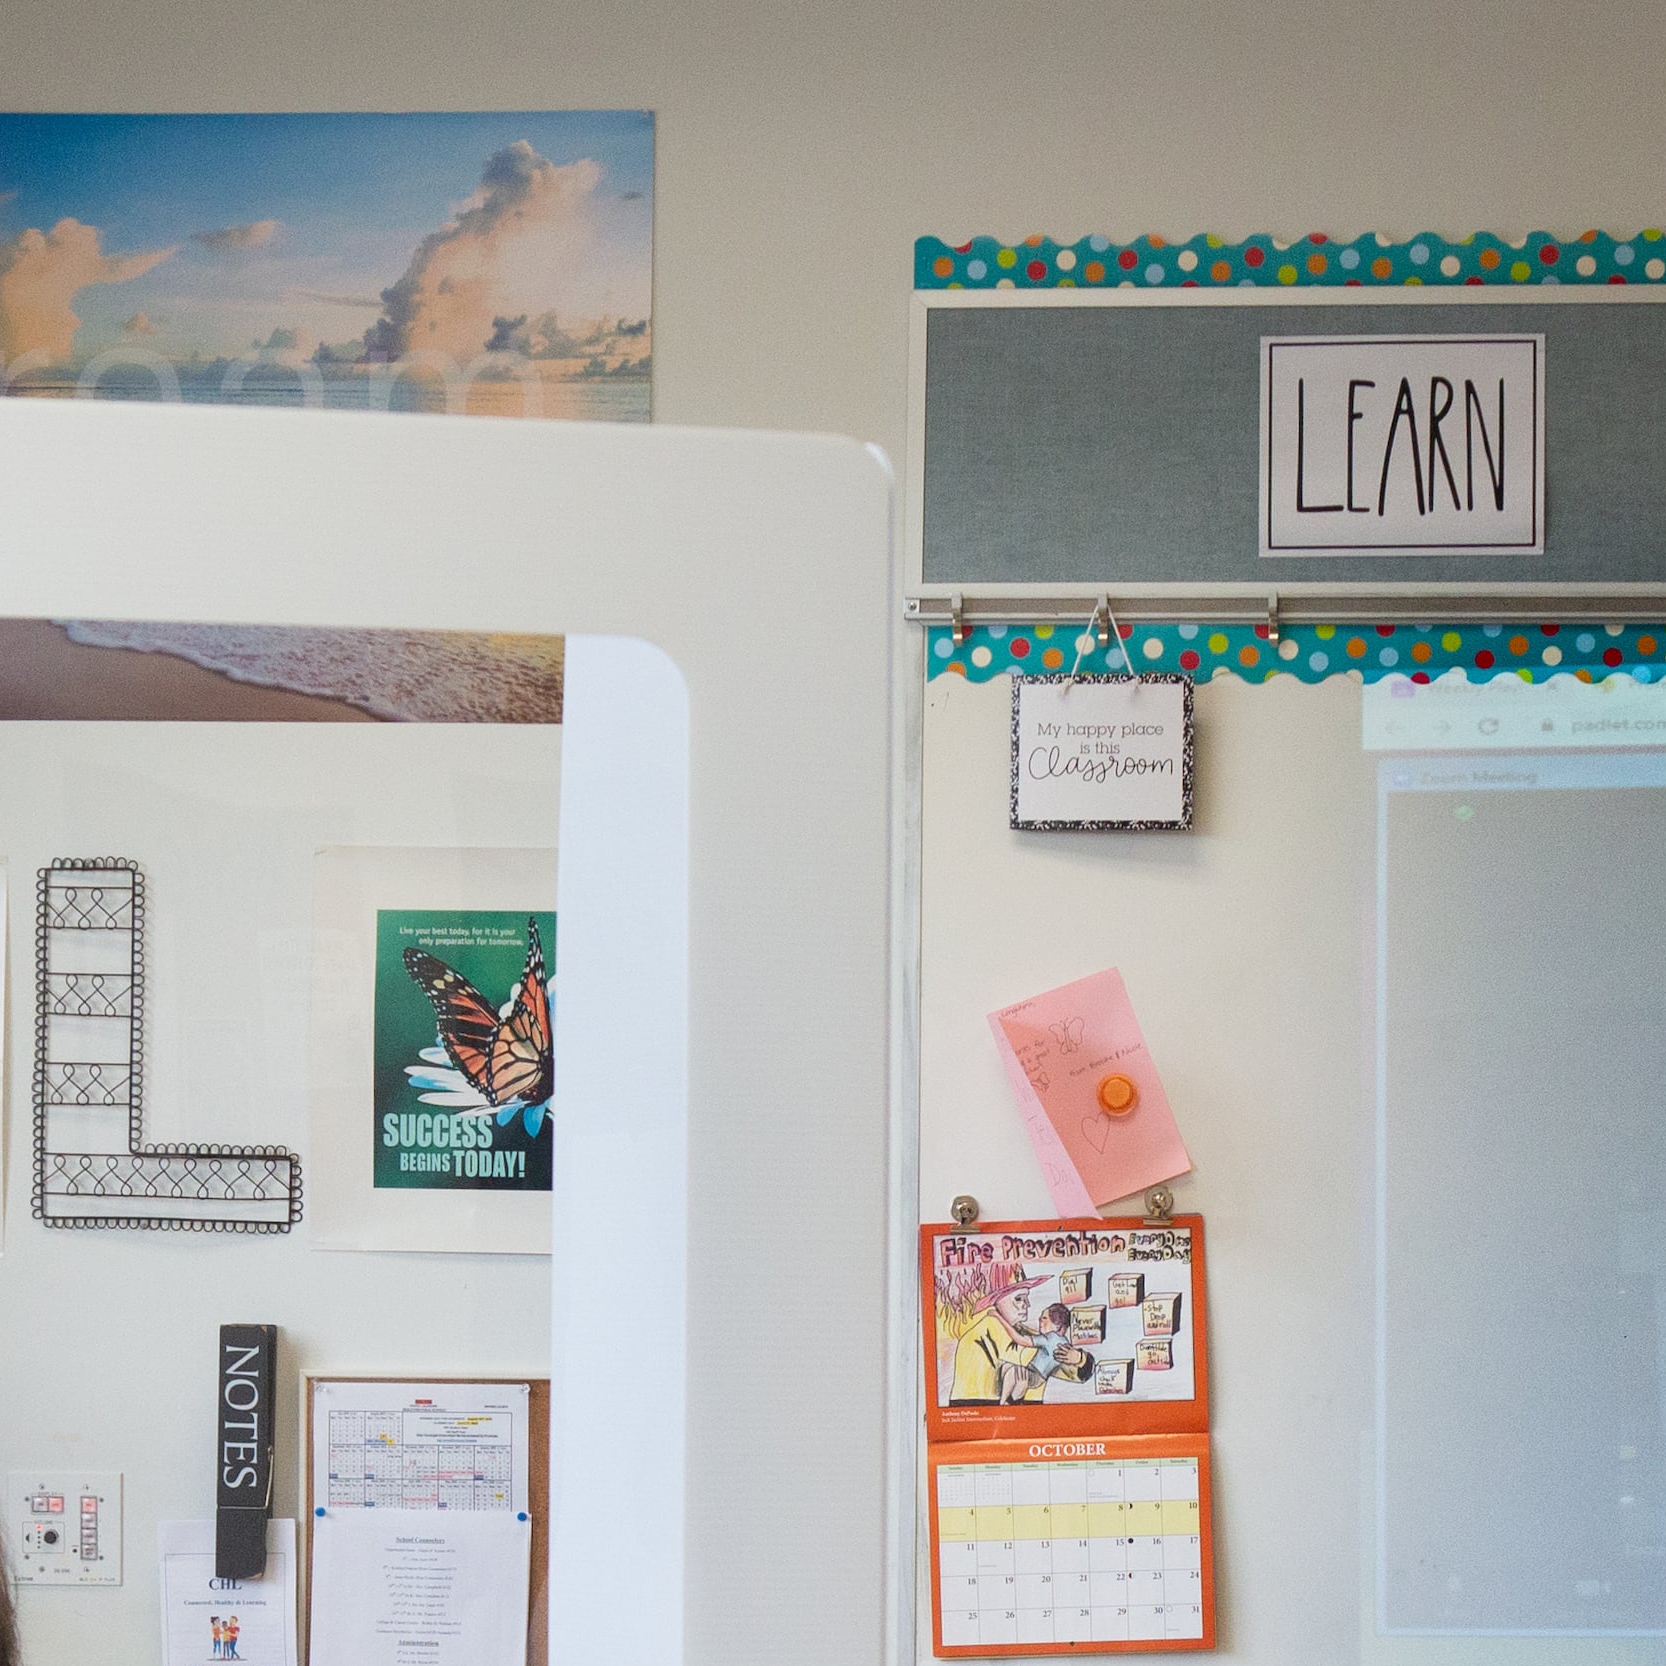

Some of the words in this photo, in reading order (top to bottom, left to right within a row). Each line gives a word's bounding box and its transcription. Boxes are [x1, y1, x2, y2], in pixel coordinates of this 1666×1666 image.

[1296, 375, 1505, 517] LEARN
[1037, 722, 1061, 738] My
[1066, 722, 1117, 739] happy
[1120, 722, 1164, 739] place
[1079, 741, 1091, 755] is
[1094, 741, 1121, 755] this
[1028, 746, 1174, 784] Classroom
[415, 928, 431, 936] your
[432, 927, 448, 935] best
[471, 927, 483, 935] for
[499, 928, 515, 937] your
[419, 937, 433, 946] only
[435, 938, 475, 946] preparation
[476, 938, 488, 946] for
[383, 1112, 493, 1149] SUCCESS
[400, 1152, 451, 1173] BEGINS
[452, 1149, 526, 1178] TODAY!
[940, 1237, 995, 1267] Fire
[1001, 1230, 1126, 1262] Prevention
[221, 1343, 260, 1490] NOTES
[1028, 1442, 1106, 1458] OCTOBER
[1154, 1468, 1159, 1476] 2
[1191, 1467, 1197, 1475] 3
[969, 1508, 974, 1516] 4
[1043, 1506, 1049, 1514] 6
[1081, 1505, 1086, 1513] 7
[1118, 1504, 1123, 1512] 8
[1155, 1502, 1160, 1510] 9
[967, 1543, 975, 1551] 11
[1004, 1542, 1012, 1550] 12
[1041, 1540, 1050, 1548] 13
[1116, 1538, 1124, 1546] 15
[1152, 1537, 1161, 1545] 16
[1189, 1536, 1198, 1544] 17
[208, 1578, 243, 1591] CHL
[967, 1577, 976, 1585] 18
[1005, 1576, 1013, 1584] 19
[1041, 1575, 1051, 1583] 20
[1079, 1574, 1087, 1582] 21
[1116, 1573, 1125, 1581] 22
[1153, 1572, 1162, 1580] 23
[1190, 1571, 1199, 1579] 24
[968, 1612, 977, 1620] 25
[1005, 1611, 1015, 1619] 26
[1043, 1610, 1052, 1618] 27
[1080, 1608, 1089, 1616] 28
[1117, 1608, 1126, 1616] 29
[1153, 1607, 1163, 1615] 30
[1191, 1606, 1200, 1614] 31
